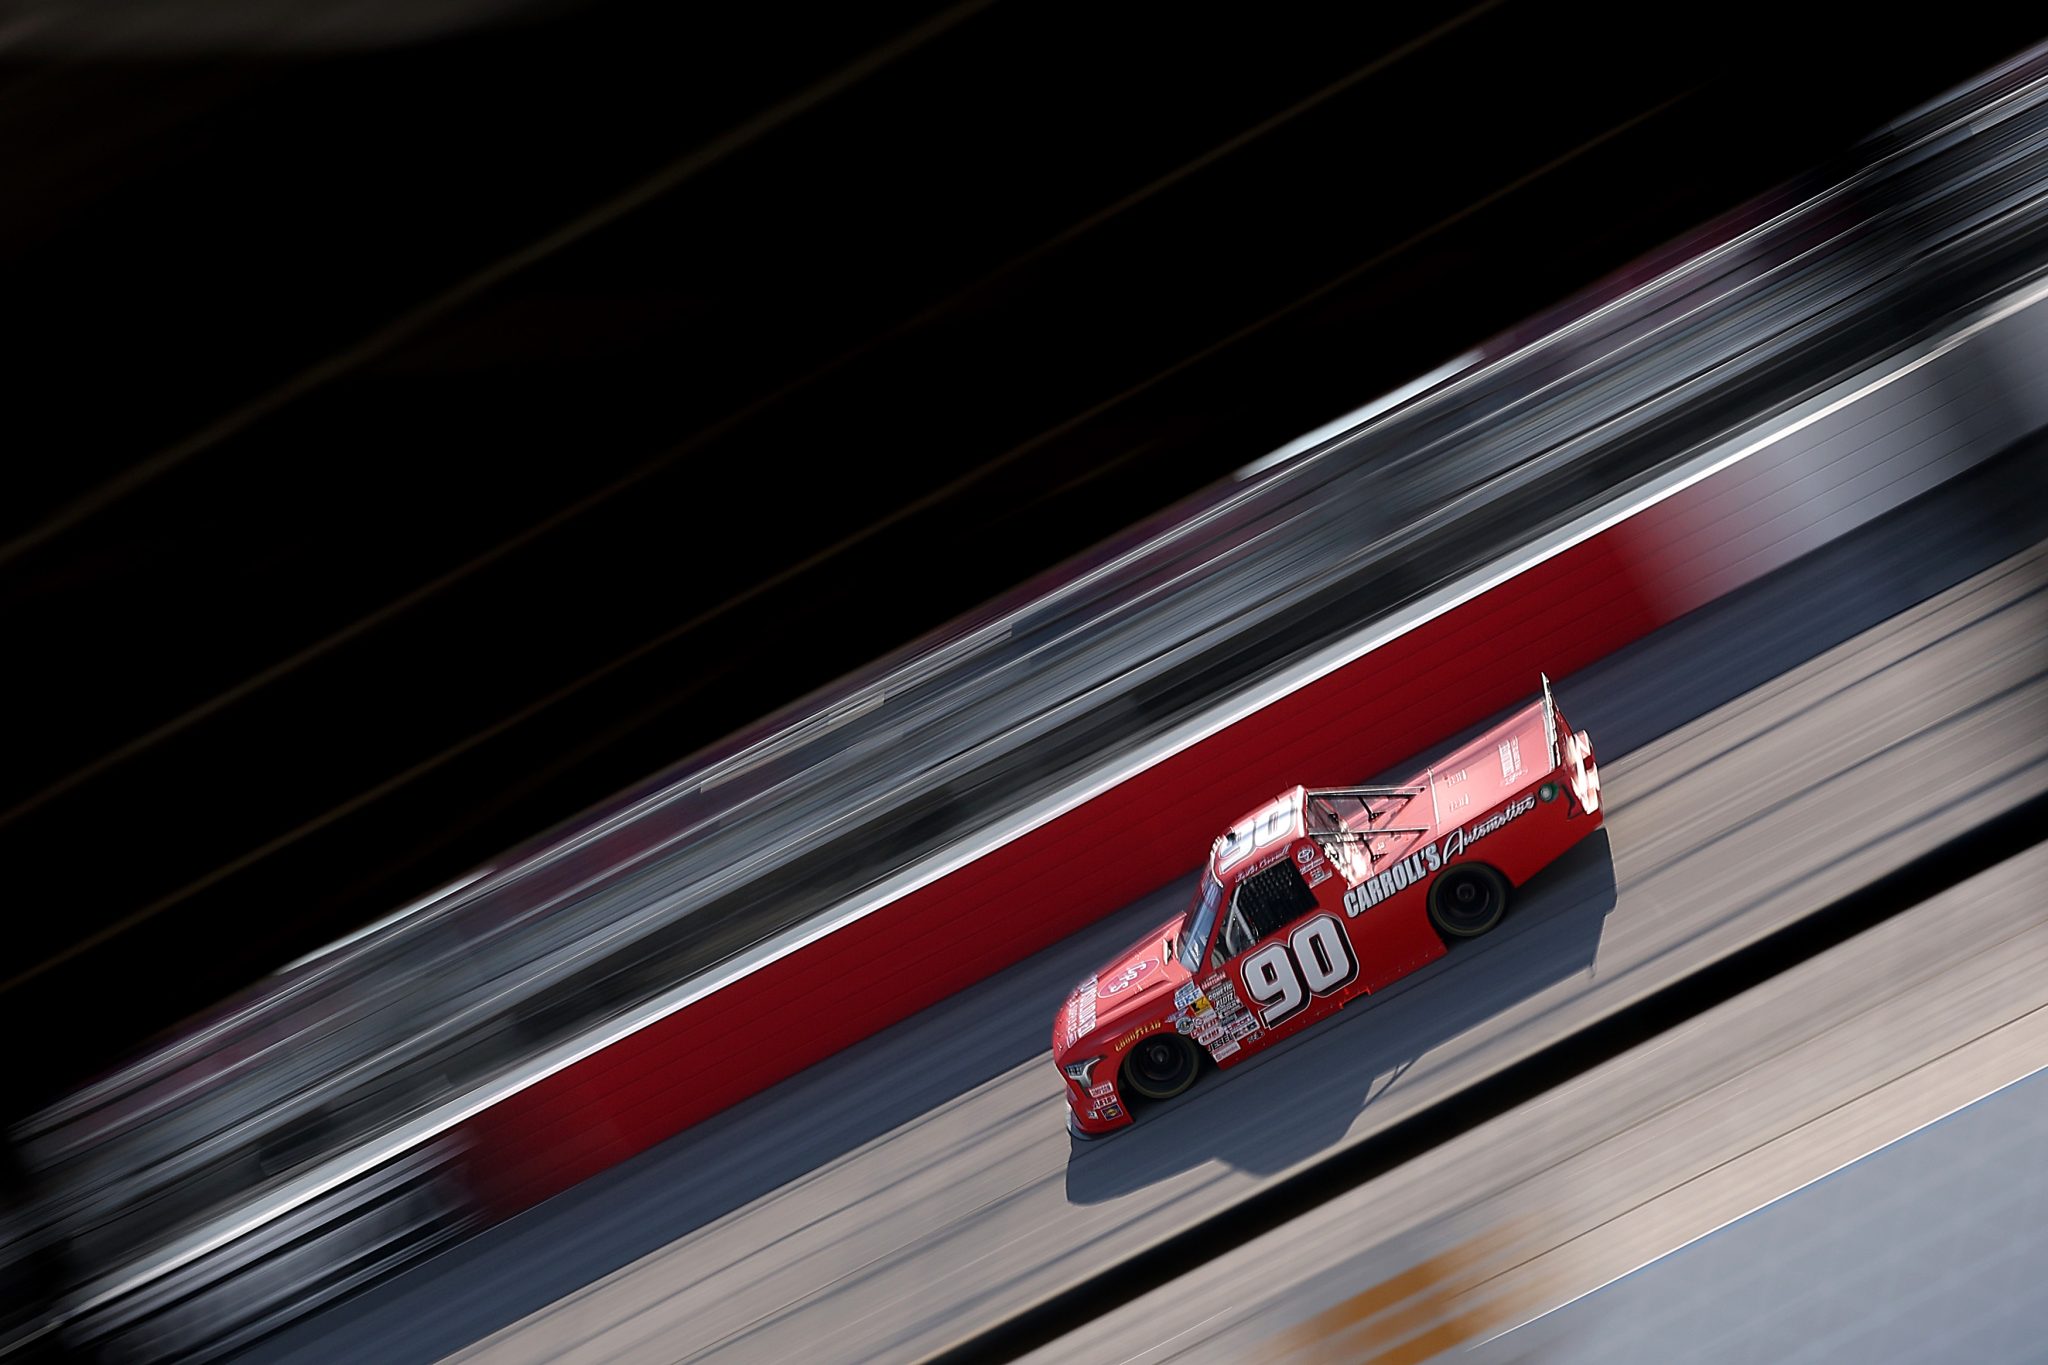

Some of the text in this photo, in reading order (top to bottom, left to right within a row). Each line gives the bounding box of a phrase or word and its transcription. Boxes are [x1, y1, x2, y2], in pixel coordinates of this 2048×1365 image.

[1219, 794, 1297, 875] 90
[1343, 794, 1536, 918] CARROLL'S Automotive
[1176, 989, 1200, 1007] SKF
[1241, 912, 1359, 1029] 90
[1115, 1021, 1161, 1052] GOODYEAR
[1208, 1031, 1233, 1051] JESEL
